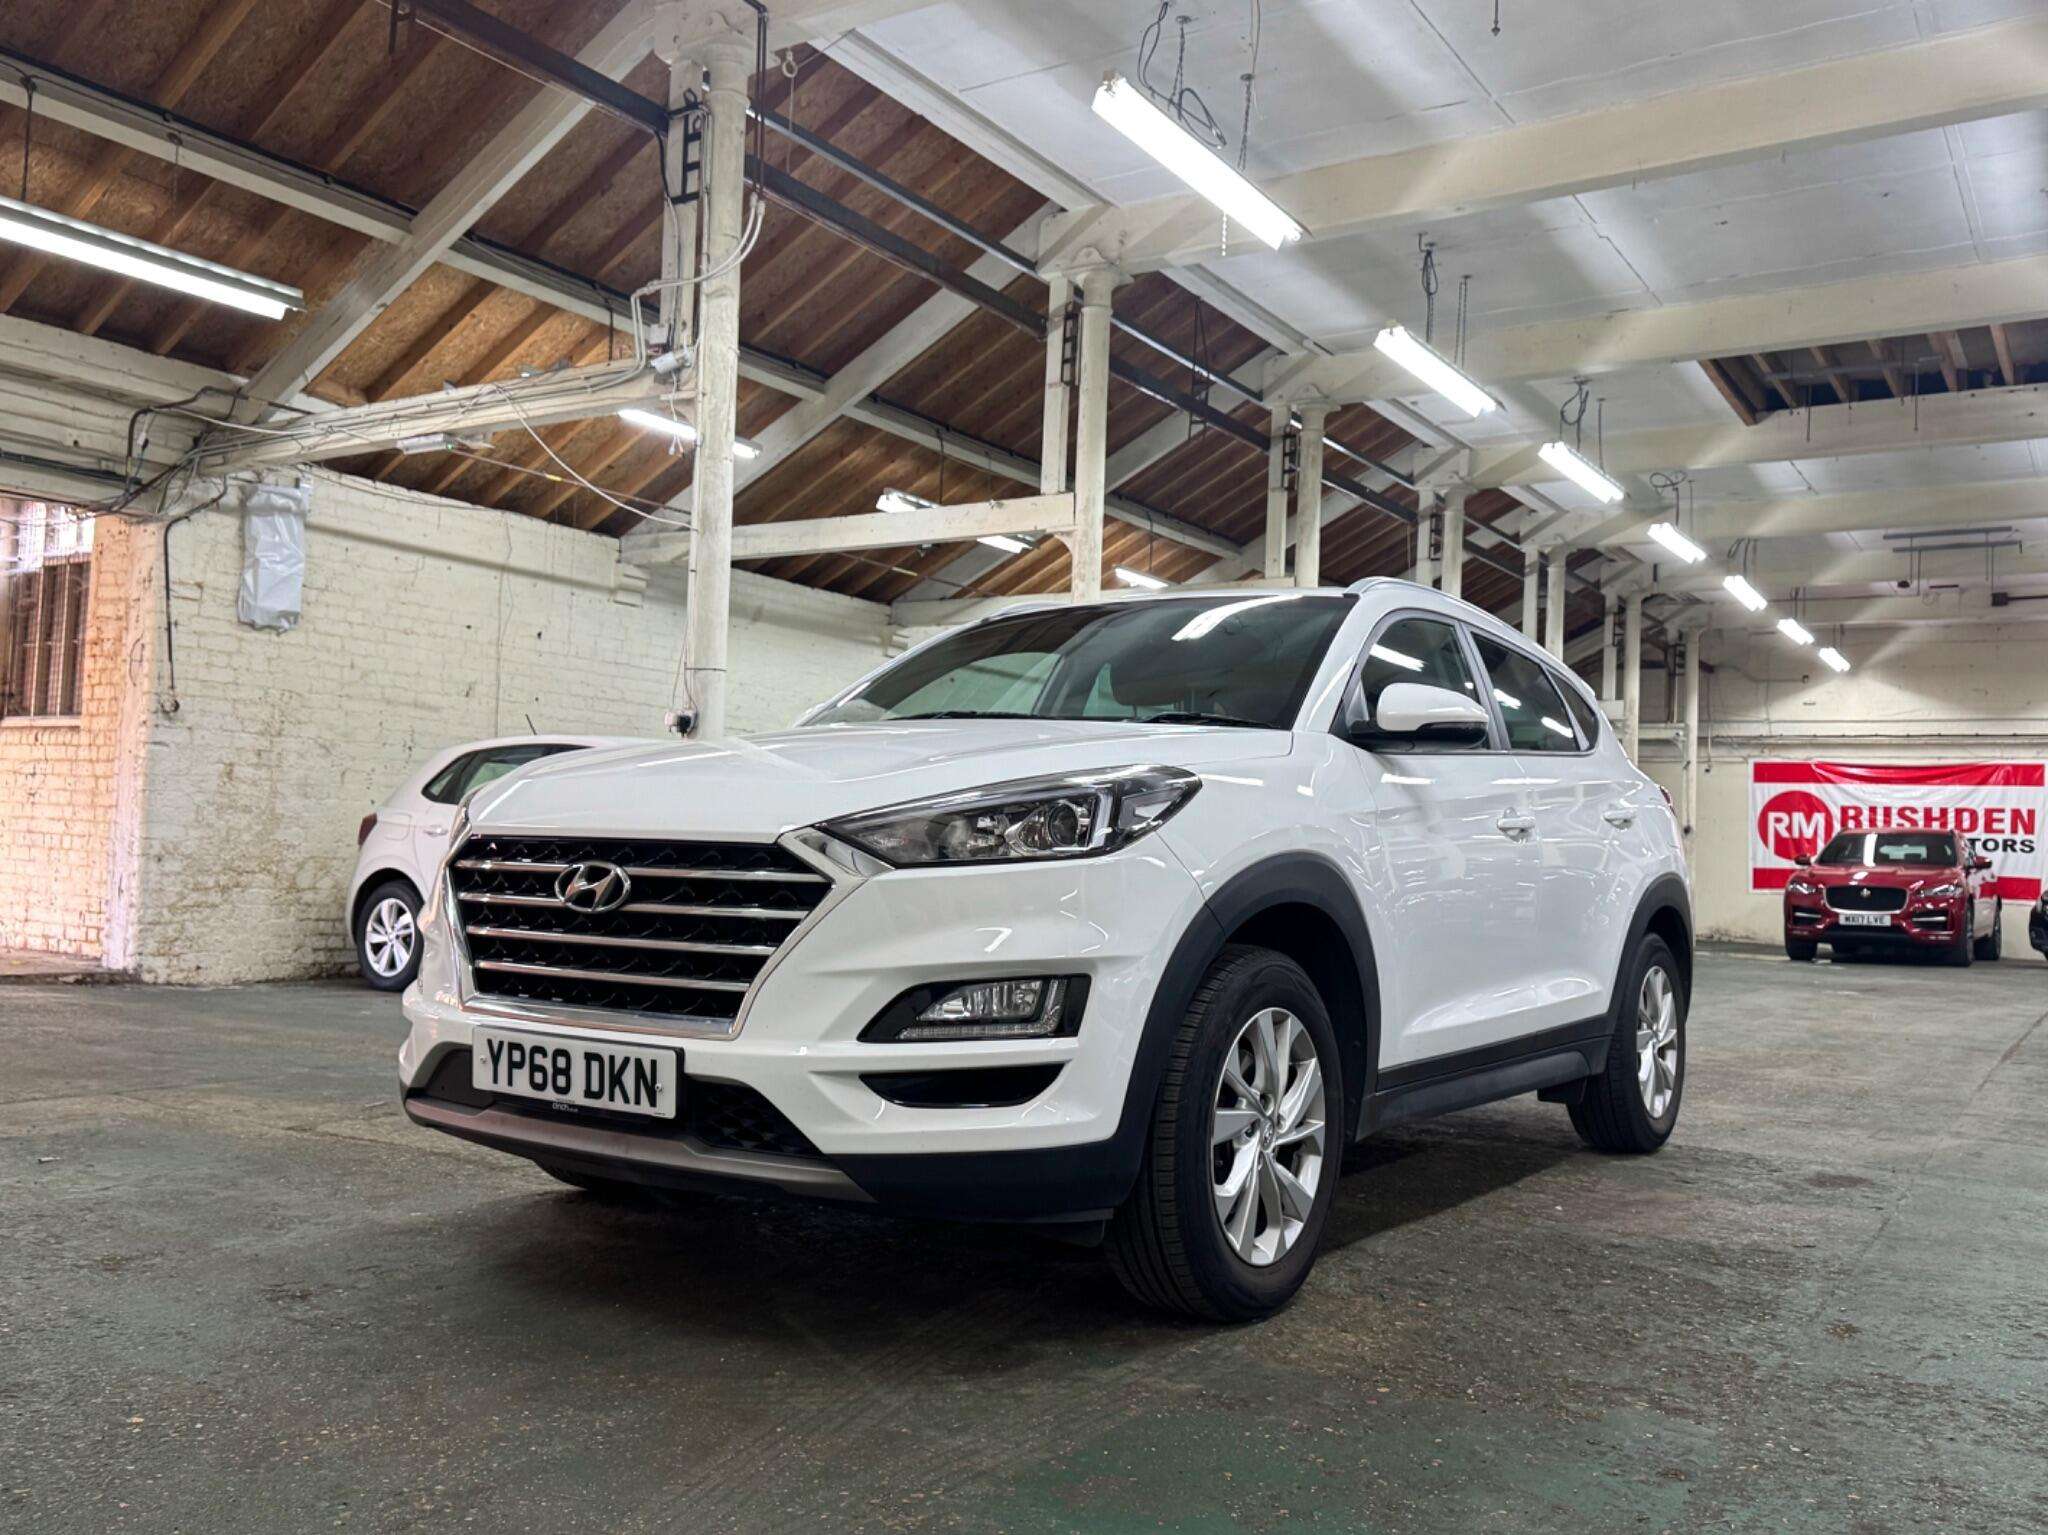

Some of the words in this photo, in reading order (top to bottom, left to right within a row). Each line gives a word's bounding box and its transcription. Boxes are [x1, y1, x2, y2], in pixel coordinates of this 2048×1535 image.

[1767, 811, 1825, 858] RM
[1840, 805, 2035, 834] RUSHDEN
[1967, 838, 2035, 853] TORS
[487, 1038, 572, 1095] YP68
[584, 1051, 658, 1108] DKN
